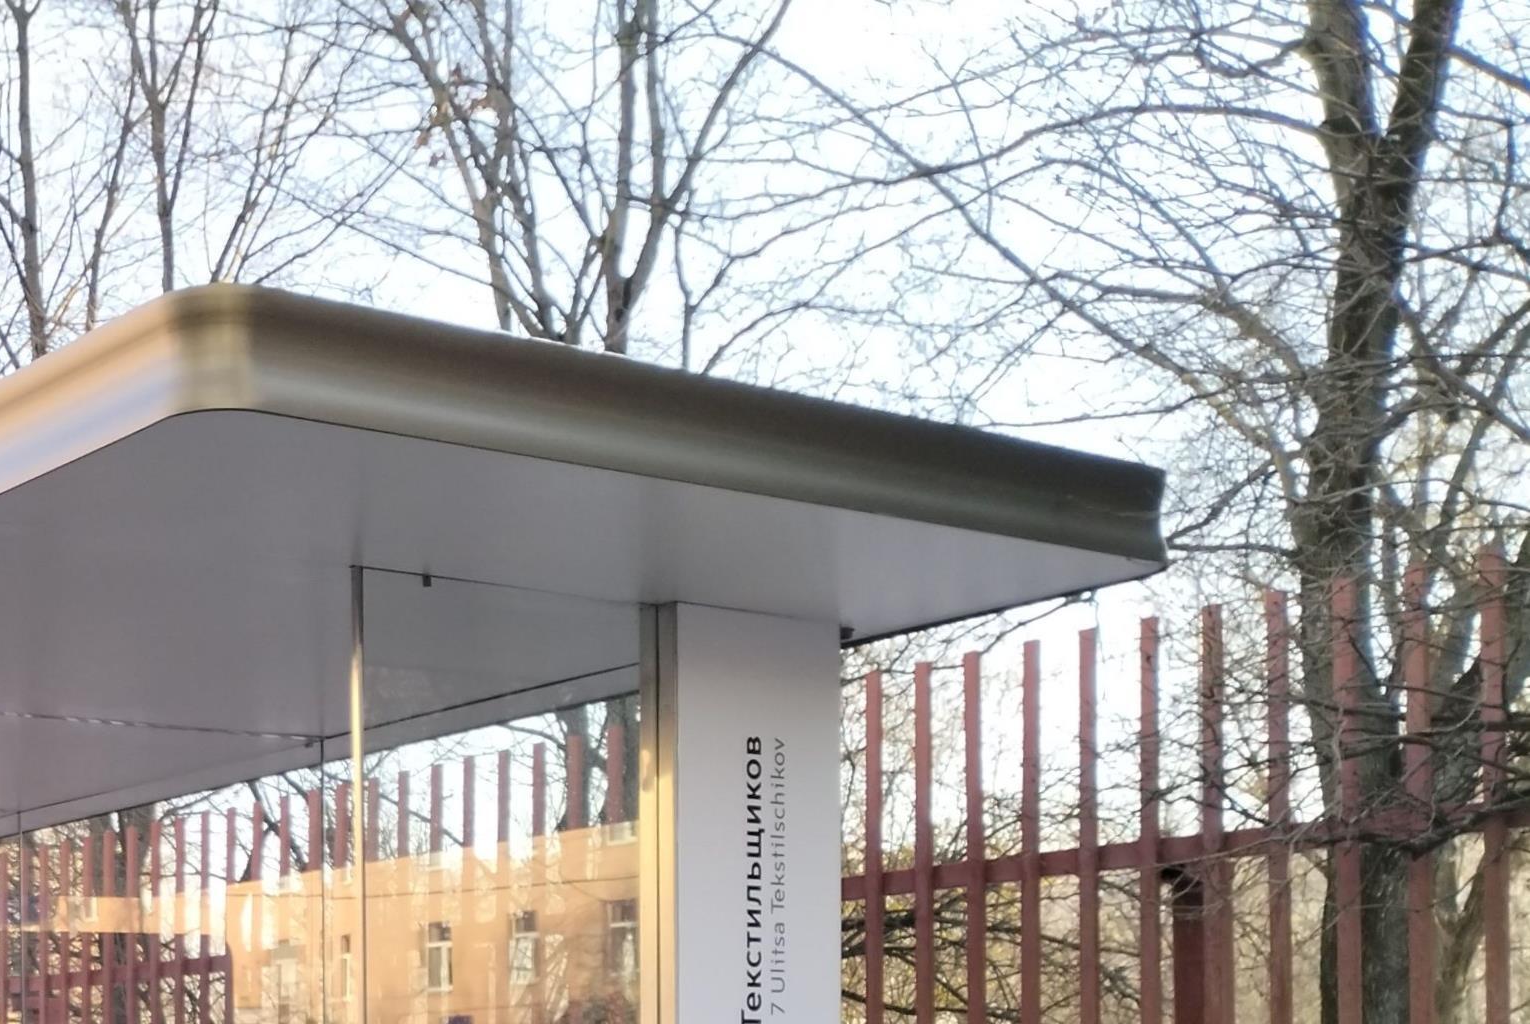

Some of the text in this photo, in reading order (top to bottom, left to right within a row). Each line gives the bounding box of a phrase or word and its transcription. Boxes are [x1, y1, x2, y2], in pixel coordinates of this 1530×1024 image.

[769, 737, 786, 1016] 7 Ulitsa Tekstilschikov
